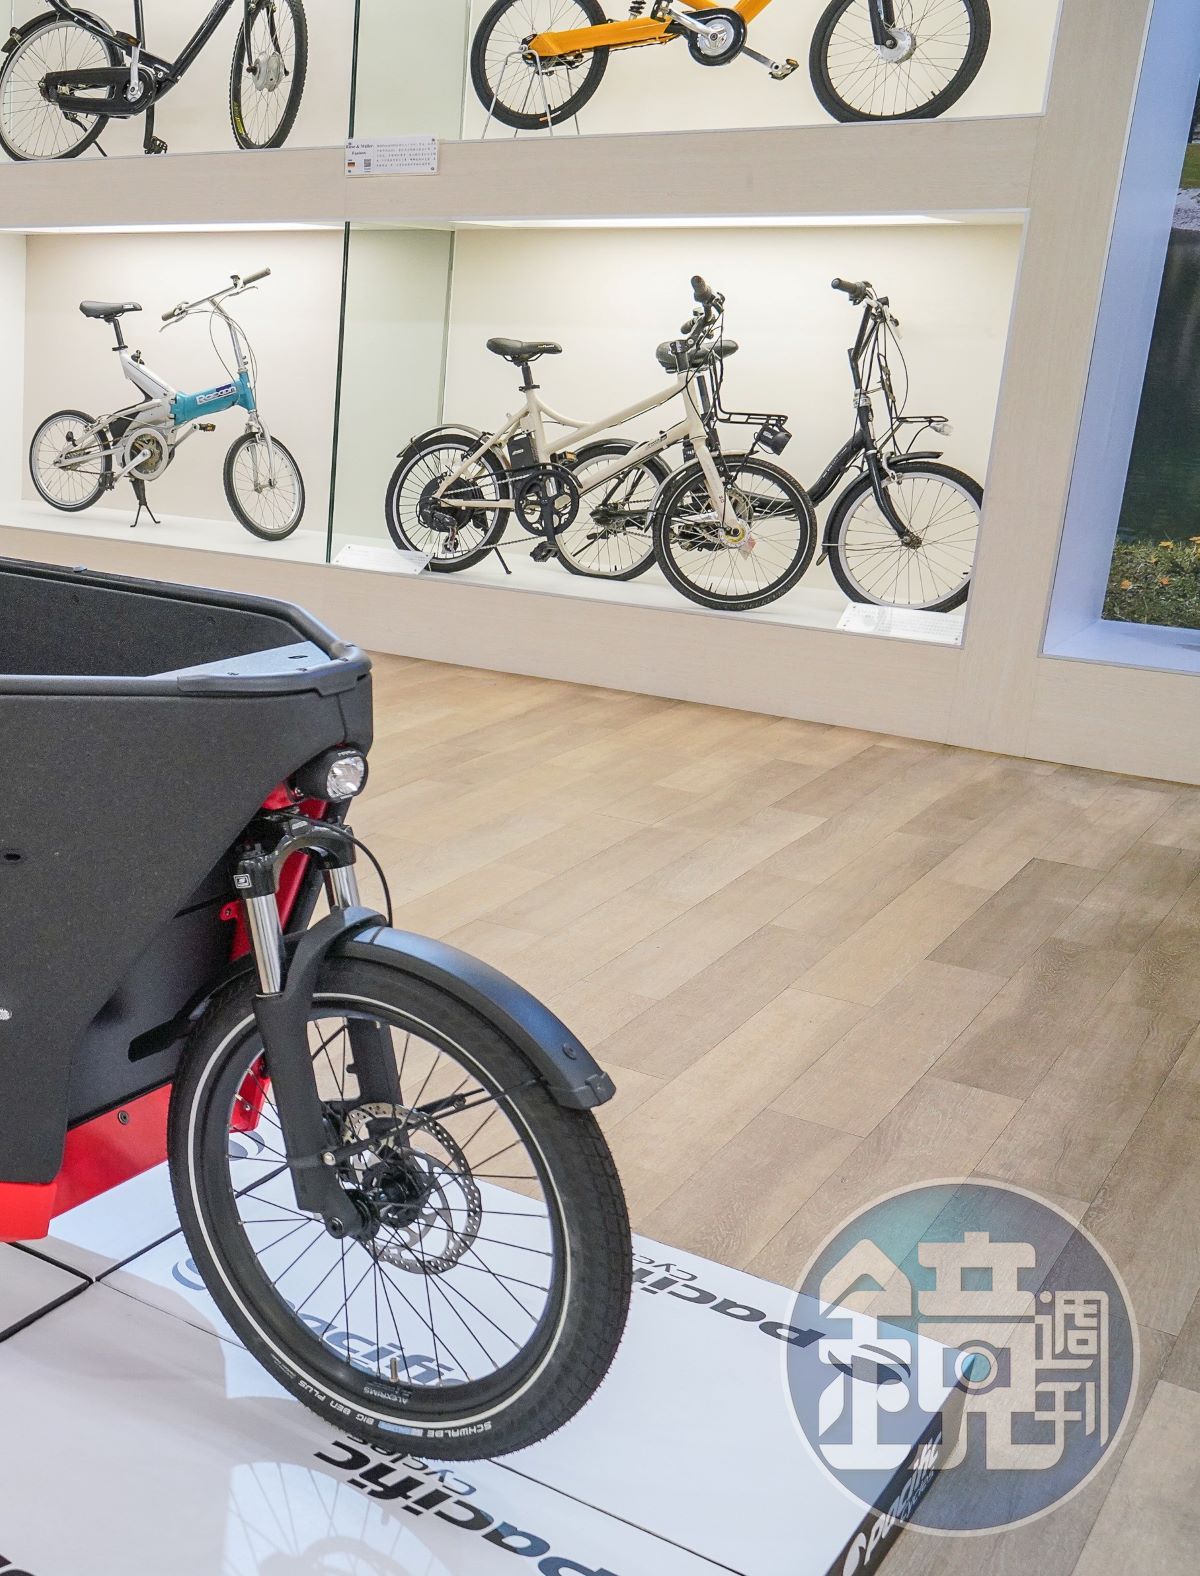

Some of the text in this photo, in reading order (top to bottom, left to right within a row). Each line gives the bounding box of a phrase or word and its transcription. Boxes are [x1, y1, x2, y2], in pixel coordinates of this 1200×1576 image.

[632, 1267, 827, 1349] Paci
[298, 1379, 327, 1401] PLUS
[329, 1401, 351, 1416] BEN
[356, 1414, 374, 1426] BIG
[426, 1420, 492, 1438] SCHWALBE
